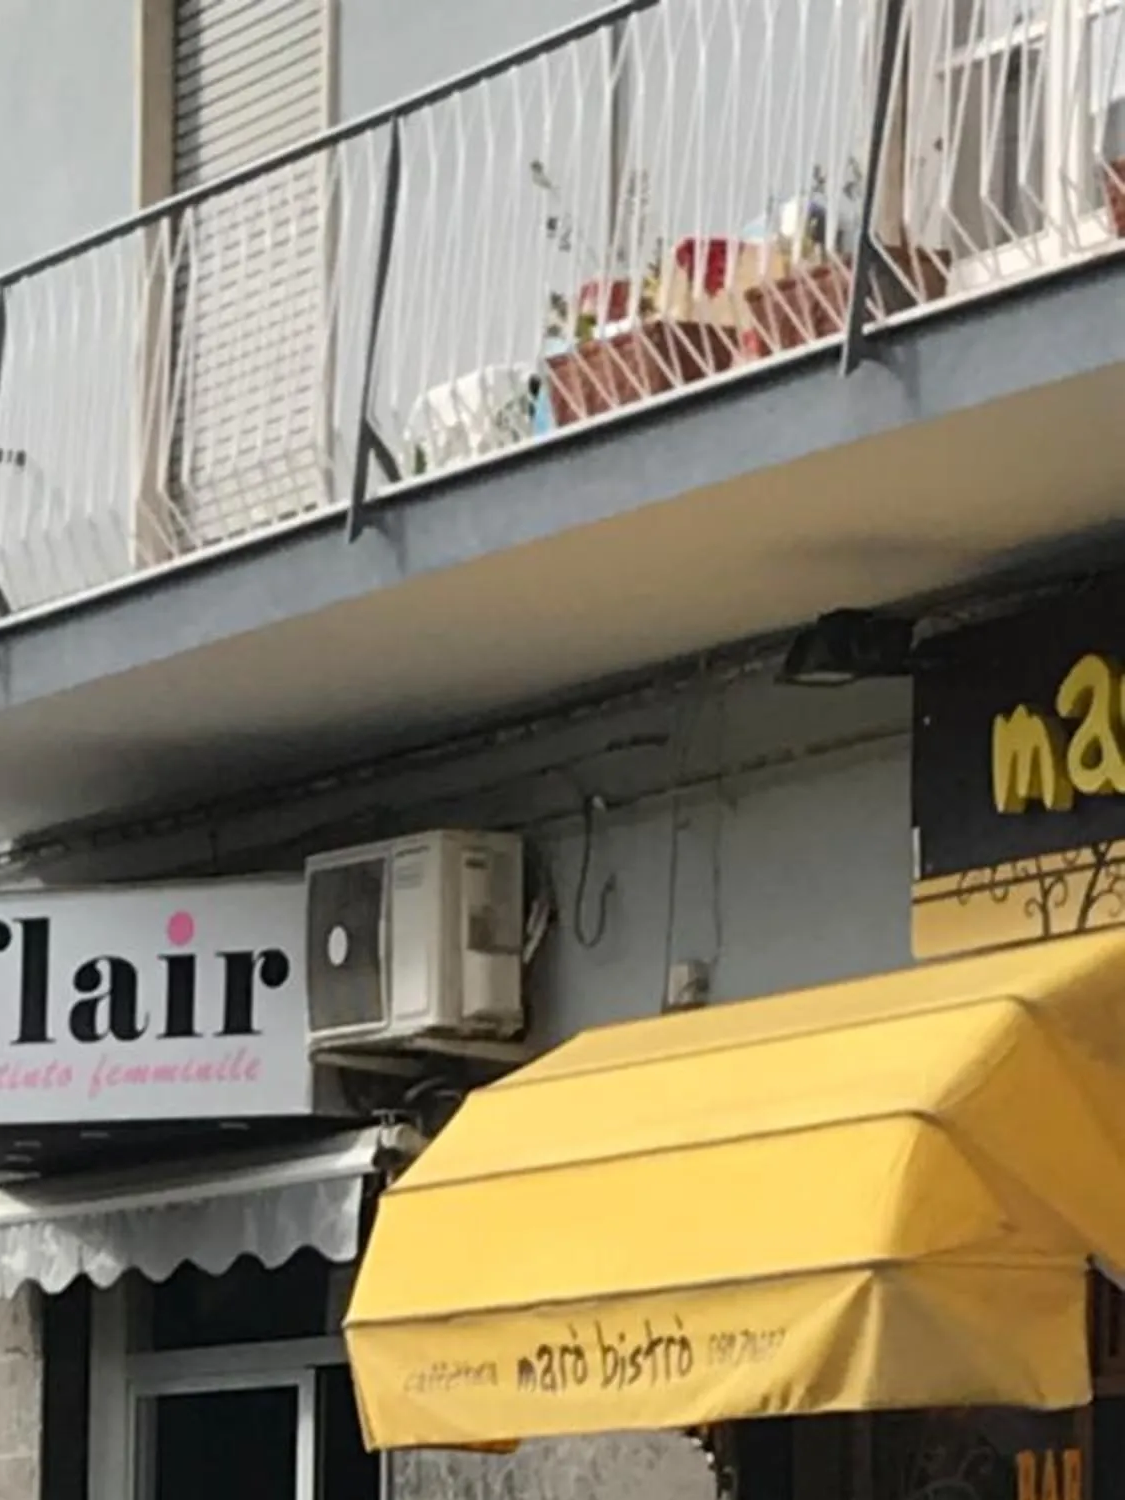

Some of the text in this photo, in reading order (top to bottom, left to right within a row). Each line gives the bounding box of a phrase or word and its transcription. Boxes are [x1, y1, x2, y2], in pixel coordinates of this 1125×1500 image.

[992, 654, 1125, 814] ma
[87, 1046, 263, 1101] femminile
[516, 1324, 588, 1394] marò
[595, 1314, 695, 1391] bistrò
